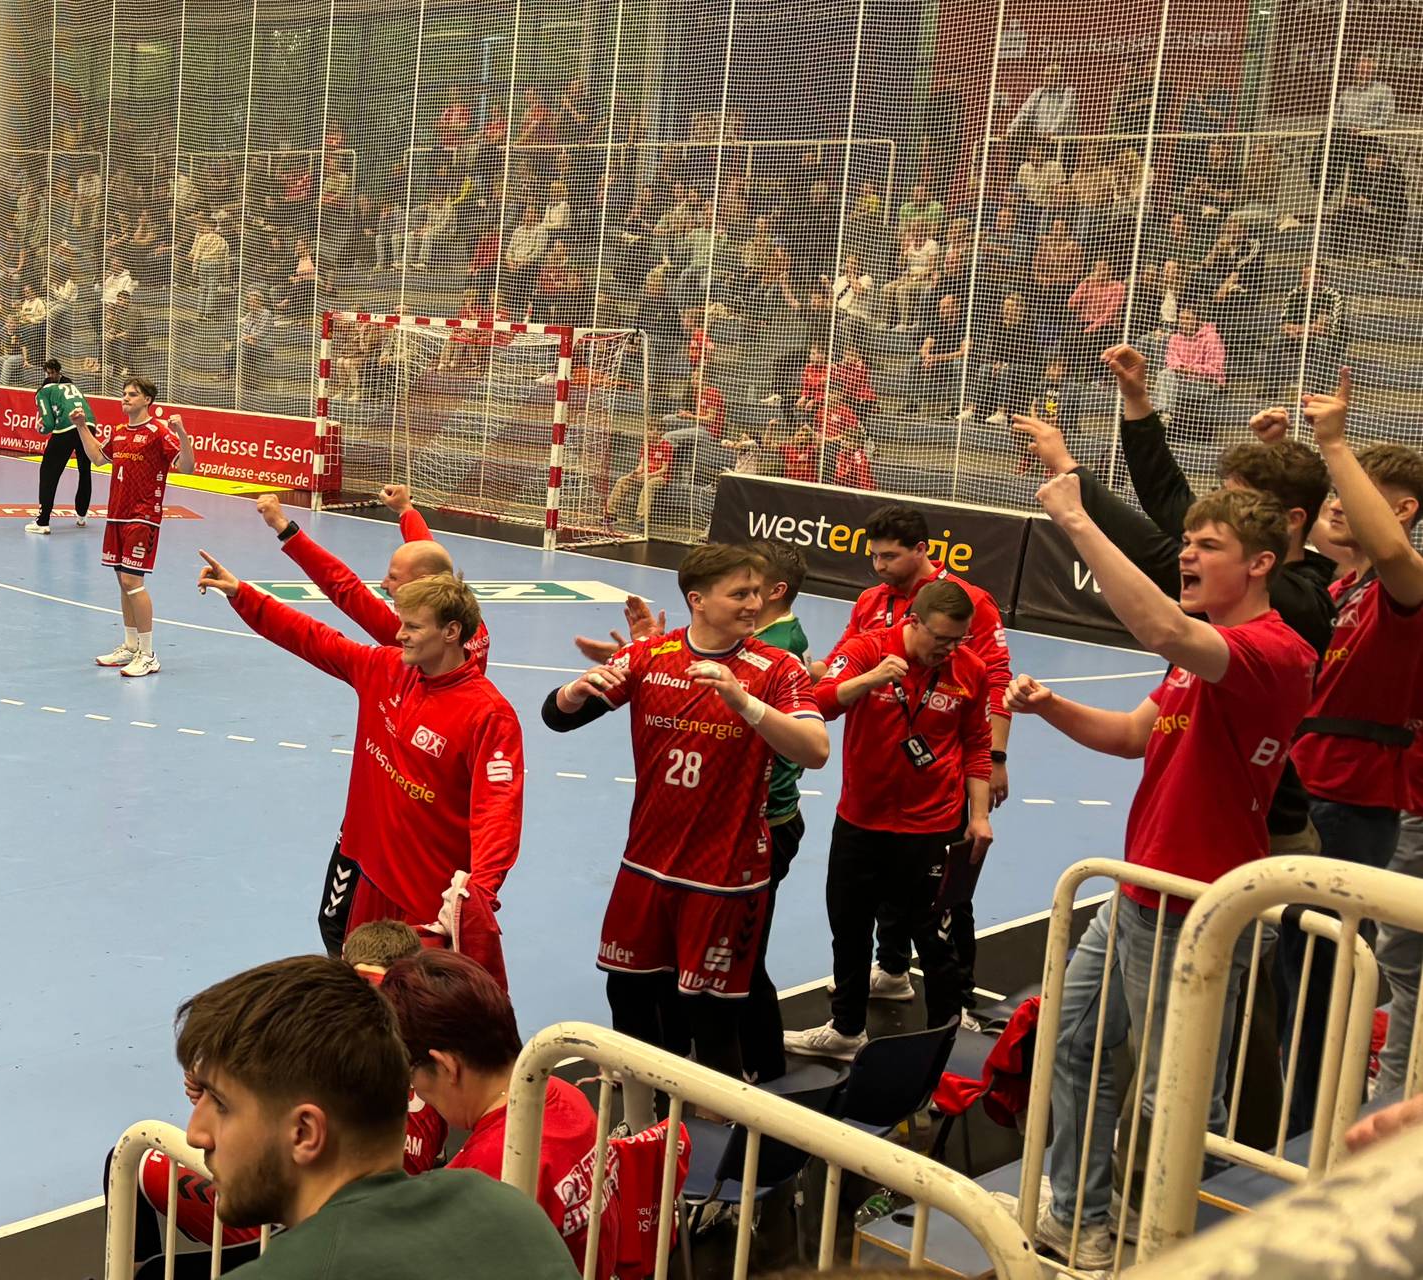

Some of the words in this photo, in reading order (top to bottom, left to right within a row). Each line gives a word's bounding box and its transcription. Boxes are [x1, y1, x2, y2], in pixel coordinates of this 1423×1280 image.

[2, 409, 45, 431] Spark
[262, 440, 314, 464] Essen
[117, 465, 124, 482] 4
[748, 511, 973, 572] westenie
[642, 671, 691, 690] Allbau
[644, 713, 744, 740] westenergie
[664, 748, 703, 788] 28
